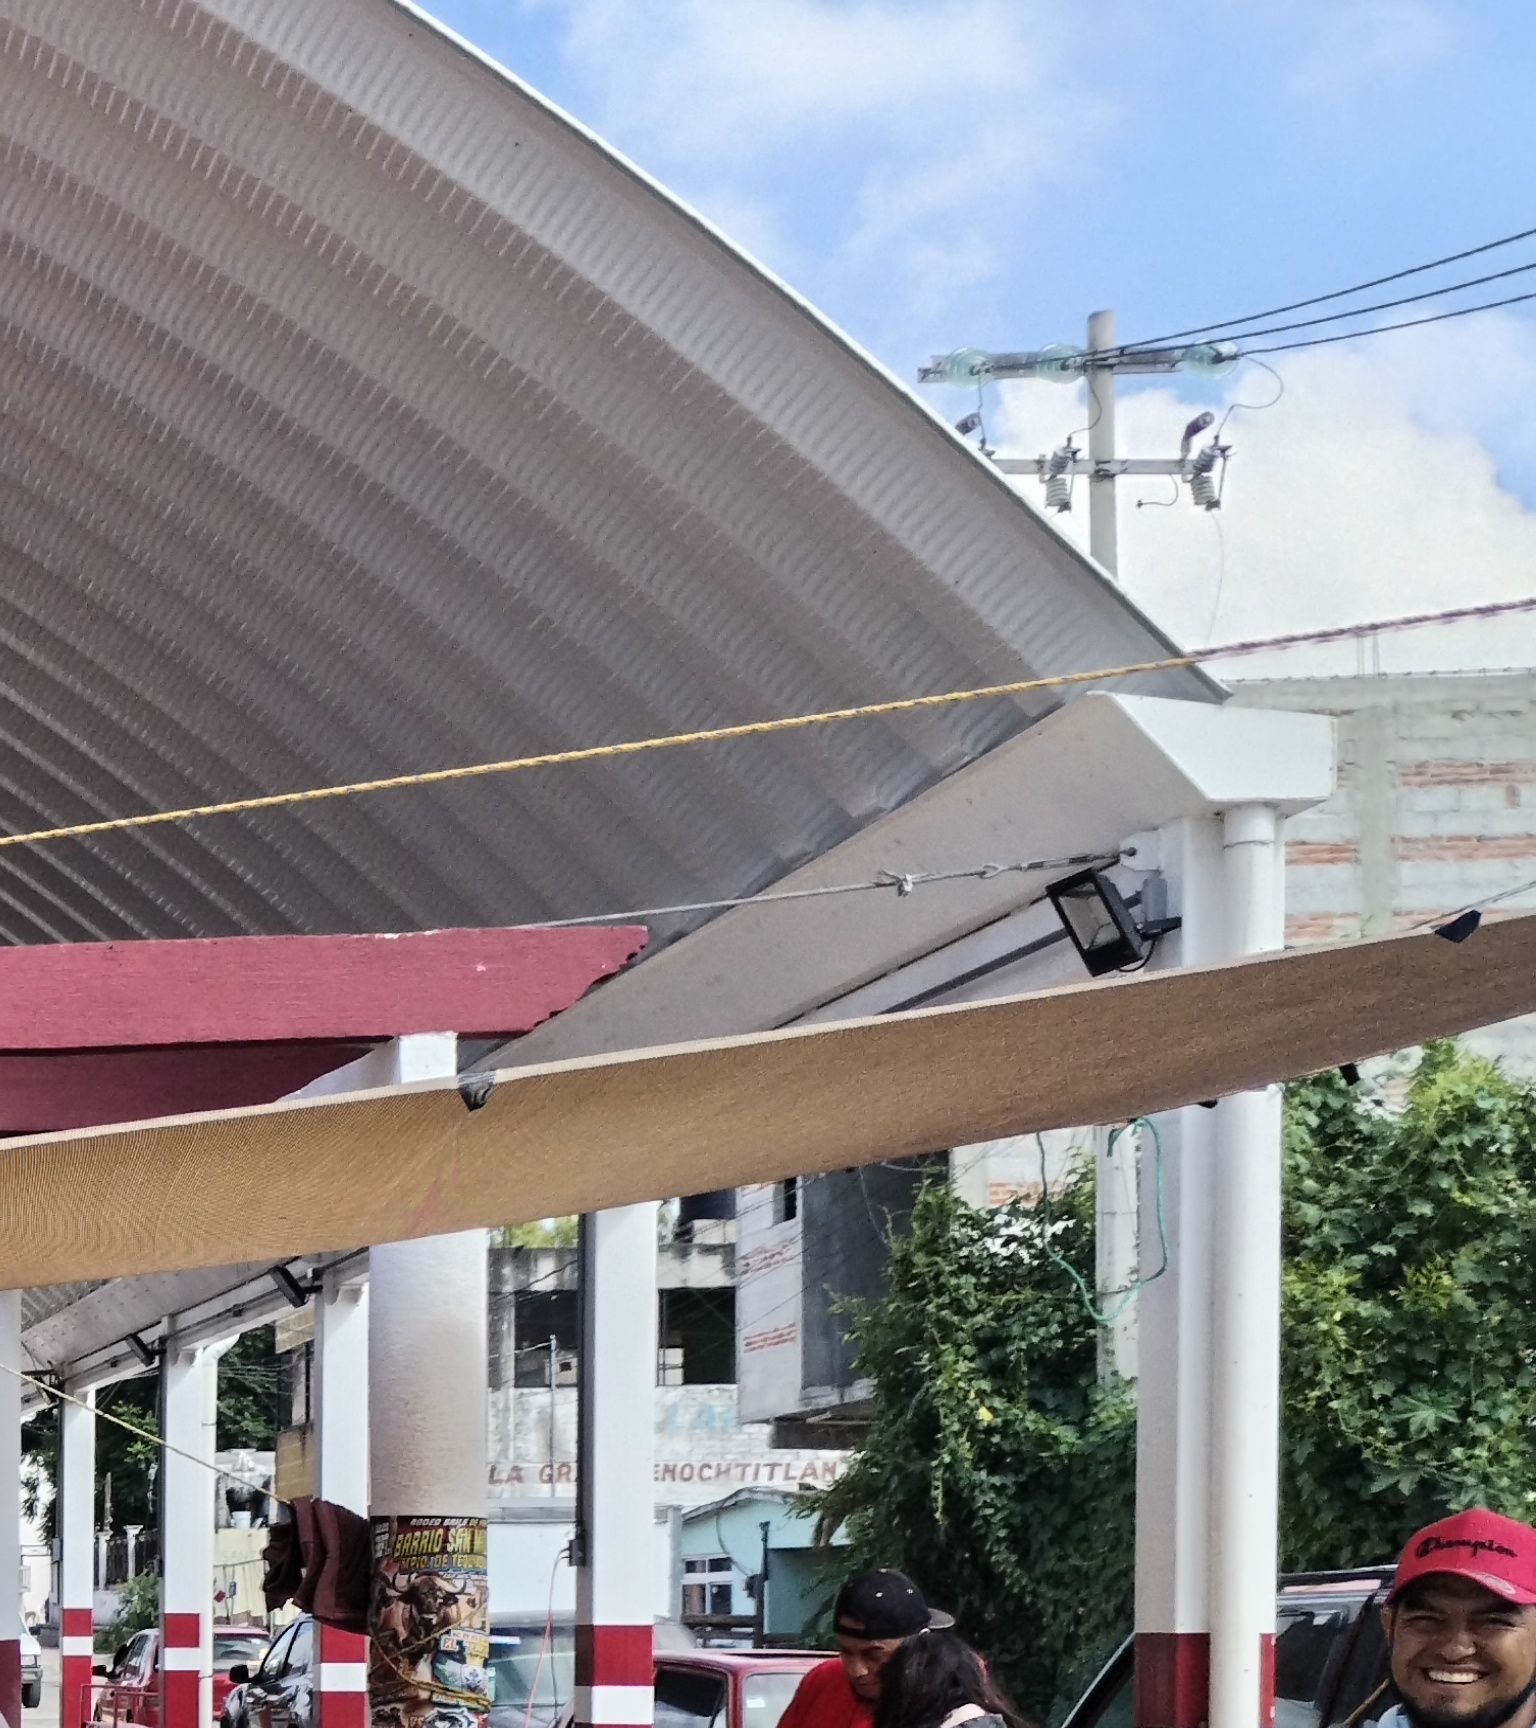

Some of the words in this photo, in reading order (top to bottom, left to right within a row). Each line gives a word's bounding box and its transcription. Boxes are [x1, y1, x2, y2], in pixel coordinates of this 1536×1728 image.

[488, 1464, 523, 1485] LA
[539, 1463, 578, 1485] GR
[394, 1527, 444, 1559] BARRIO
[447, 1525, 471, 1553] SAN
